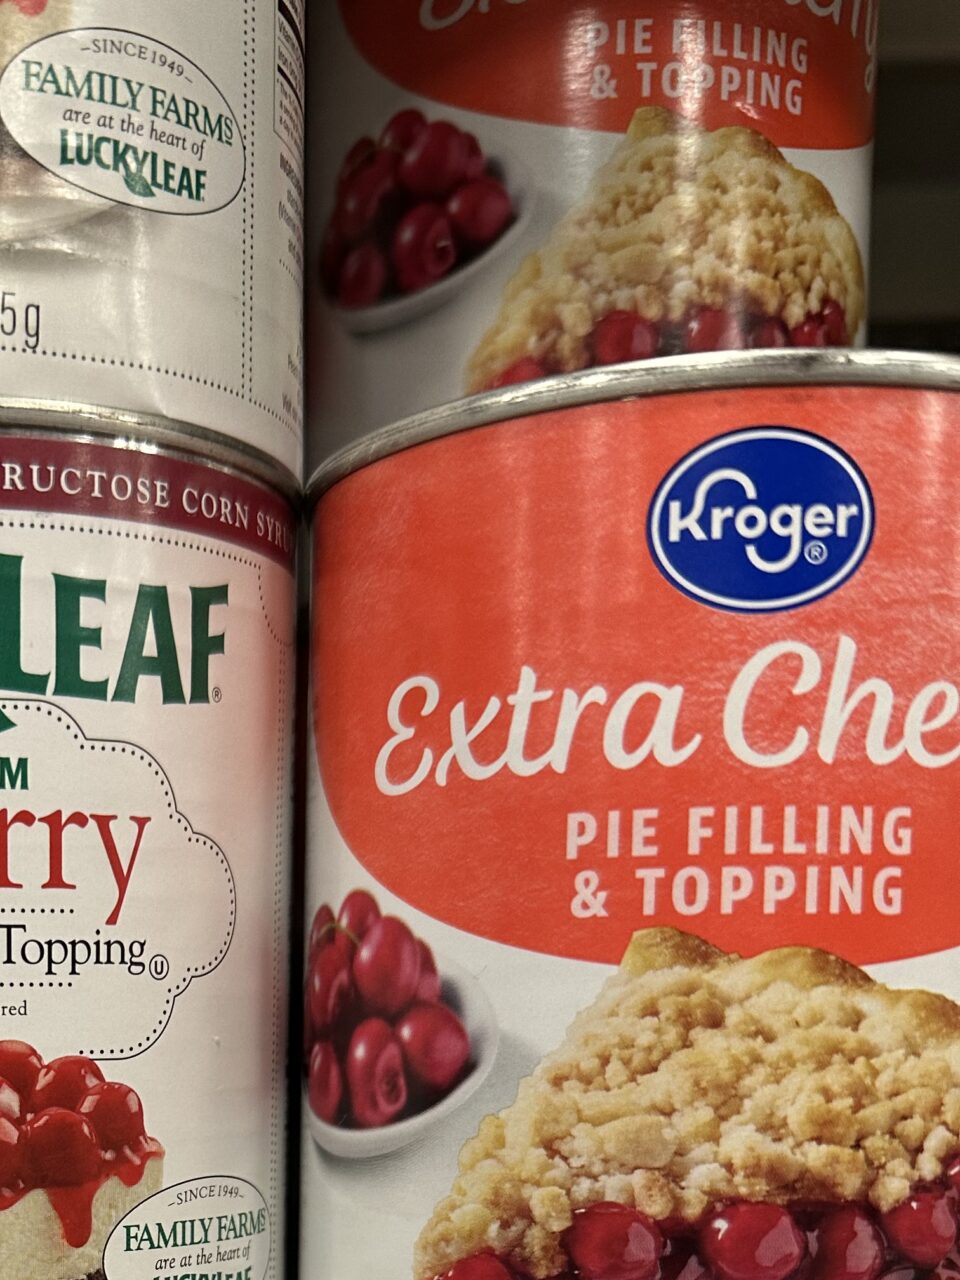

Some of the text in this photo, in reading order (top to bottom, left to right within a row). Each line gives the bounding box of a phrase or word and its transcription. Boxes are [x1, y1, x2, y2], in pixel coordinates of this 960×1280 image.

[92, 38, 185, 77] SINCE 1949
[587, 18, 809, 74] PIE FILLING
[21, 60, 145, 112] FAMILY
[149, 85, 234, 147] FARMS
[590, 61, 803, 117] & TOPPING
[62, 107, 207, 161] are at the heart of
[182, 487, 249, 531] CORN
[668, 467, 859, 574] Kroger
[373, 634, 960, 796] Extra Che
[565, 804, 914, 860] PIE FILLING
[570, 865, 905, 919] & TOPPING
